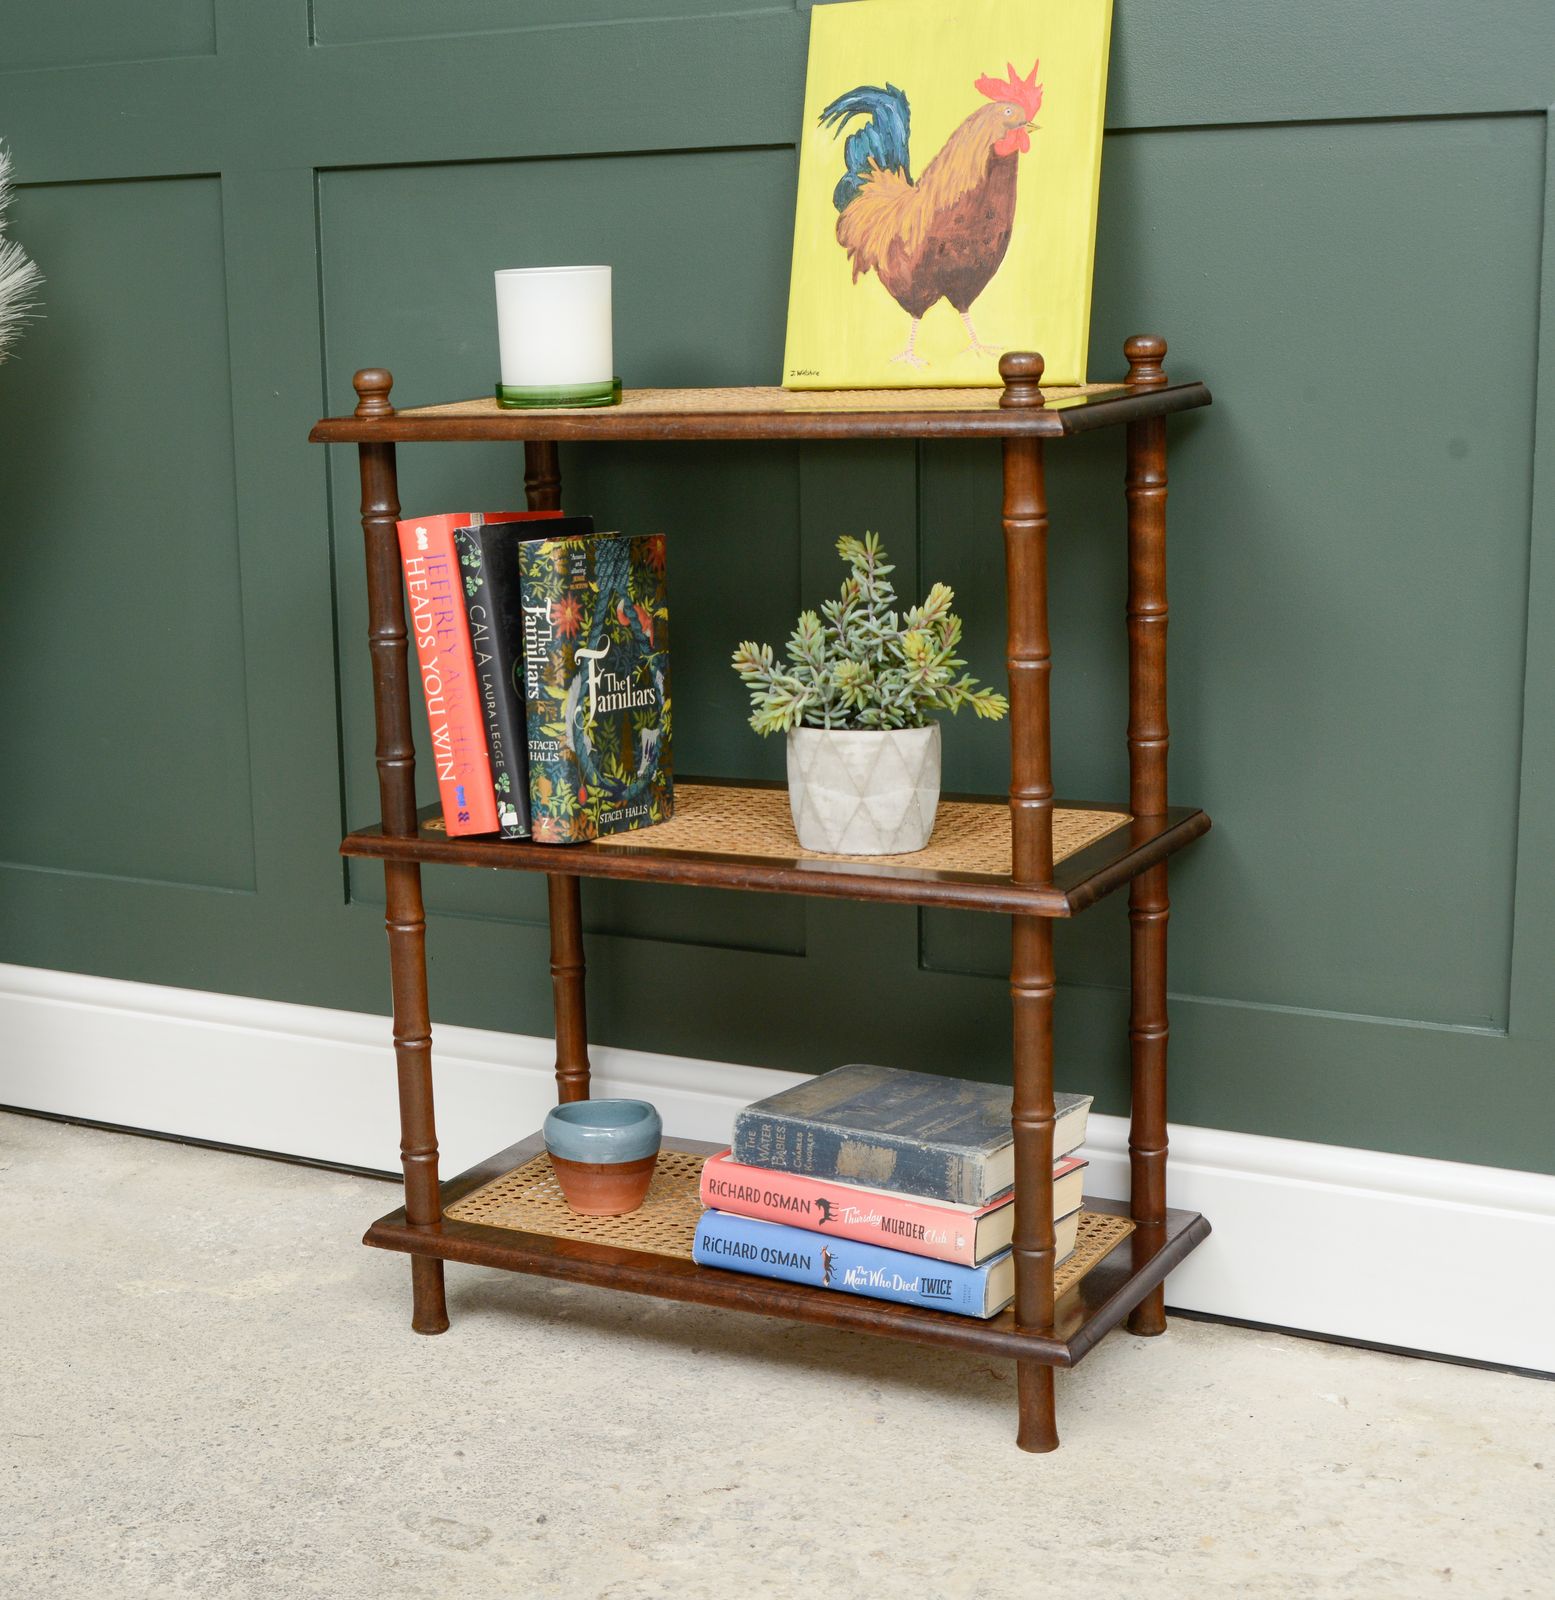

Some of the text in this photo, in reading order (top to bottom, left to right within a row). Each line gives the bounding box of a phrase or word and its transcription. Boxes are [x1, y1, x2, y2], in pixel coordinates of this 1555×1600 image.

[424, 553, 460, 656] JEFFREY
[470, 605, 493, 667] CALA
[521, 595, 557, 700] Familiars
[538, 625, 553, 656] The
[406, 557, 457, 781] HEADS YOU WIN
[573, 633, 657, 730] Familiars
[604, 673, 627, 693] The
[482, 674, 505, 768] LAURA LEGGE
[528, 741, 560, 751] STACEY
[529, 752, 560, 762] HALLS
[600, 804, 648, 824] STACEY HALLS
[745, 1131, 757, 1149] THE
[757, 1124, 772, 1162] WATER
[763, 1191, 811, 1214] OSMAN
[840, 1206, 882, 1226] Thursday
[881, 1216, 925, 1241] MURDER
[924, 1230, 948, 1245] Club
[760, 1247, 811, 1270] OSMAN
[856, 1265, 868, 1276] The
[843, 1269, 867, 1291] Man
[868, 1266, 892, 1289] Who
[892, 1274, 919, 1293] Died
[921, 1277, 952, 1296] TWICE
